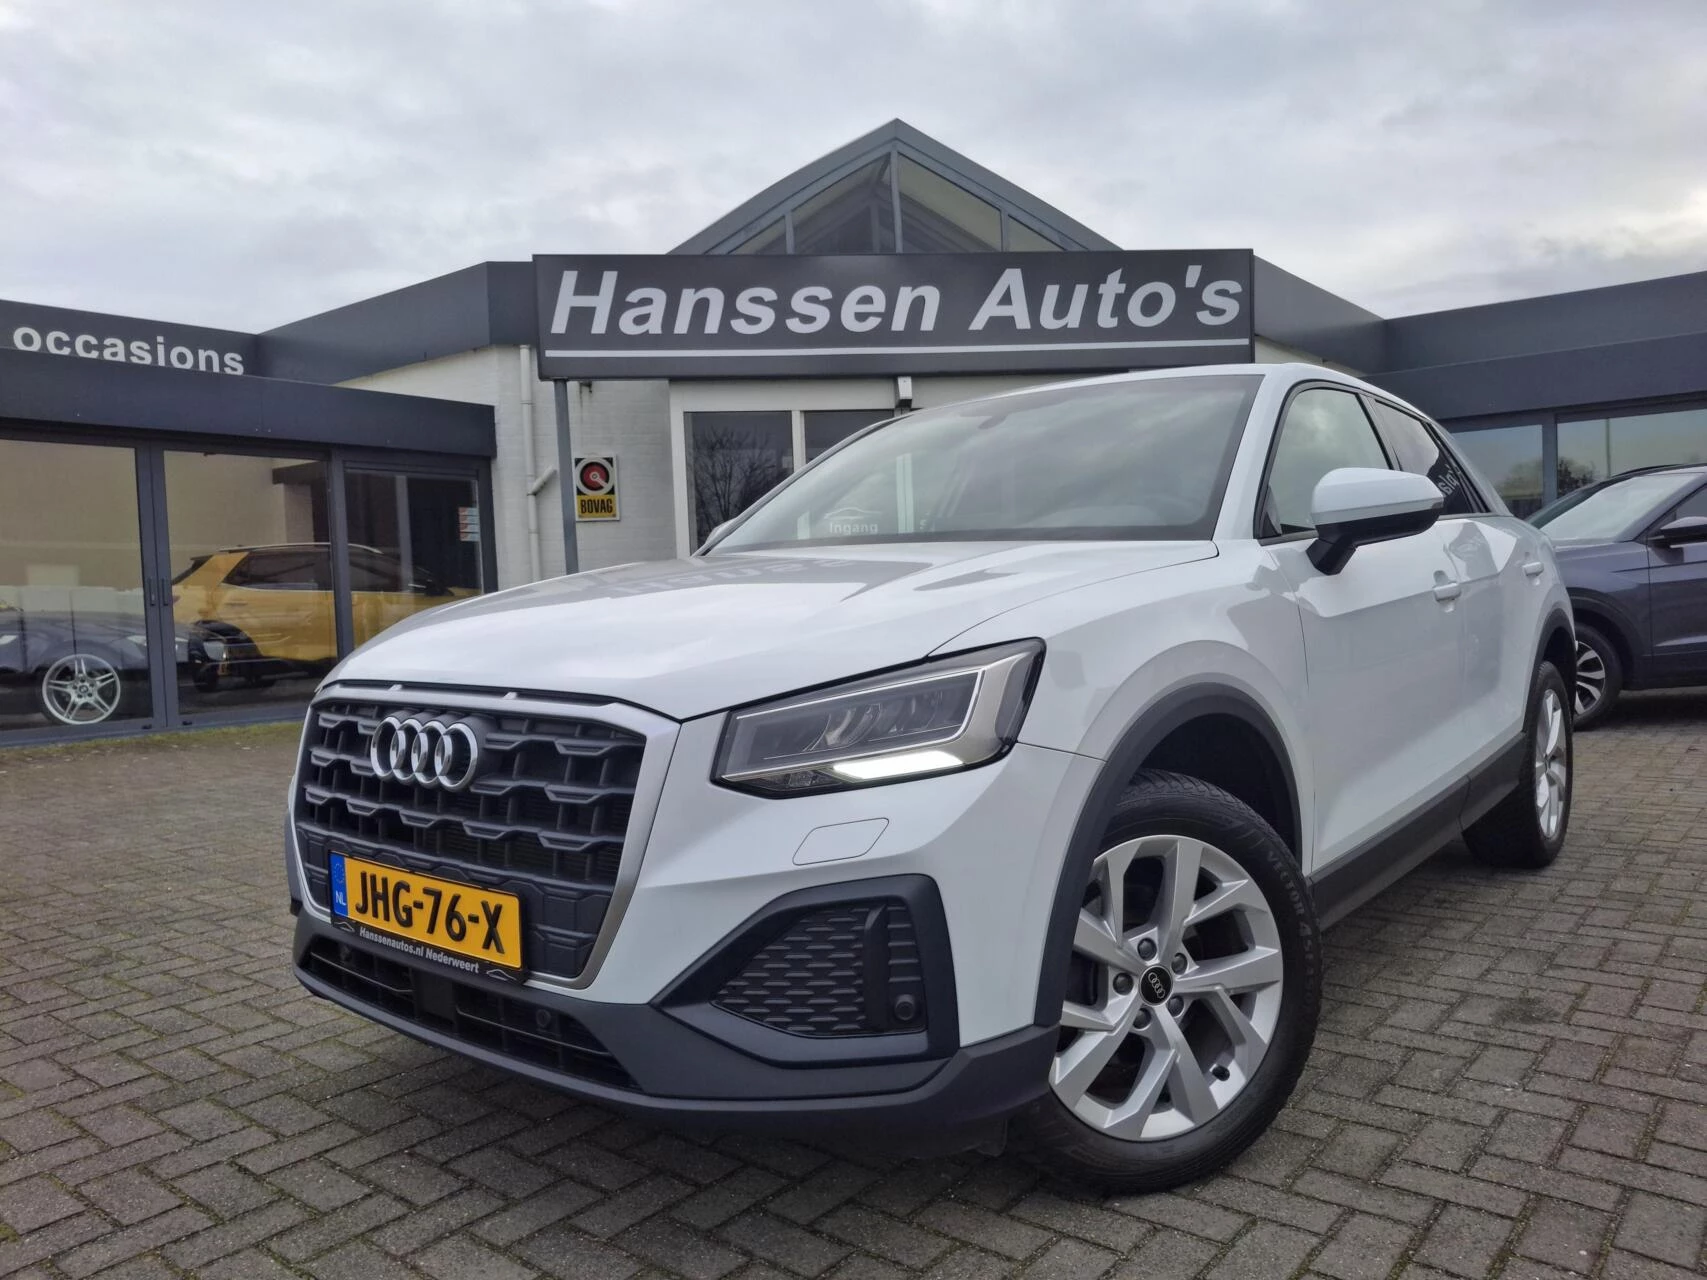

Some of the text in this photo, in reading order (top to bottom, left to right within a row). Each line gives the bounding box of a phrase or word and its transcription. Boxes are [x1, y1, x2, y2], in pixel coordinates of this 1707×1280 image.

[550, 265, 1243, 335] Hanssen Auto's
[13, 327, 244, 376] occasions
[580, 499, 613, 514] BOVAG
[829, 522, 879, 536] Ingang
[335, 891, 347, 906] NL
[355, 870, 505, 955] JHG-76-X
[359, 926, 480, 974] Hanssenautos.nl Nederweert
